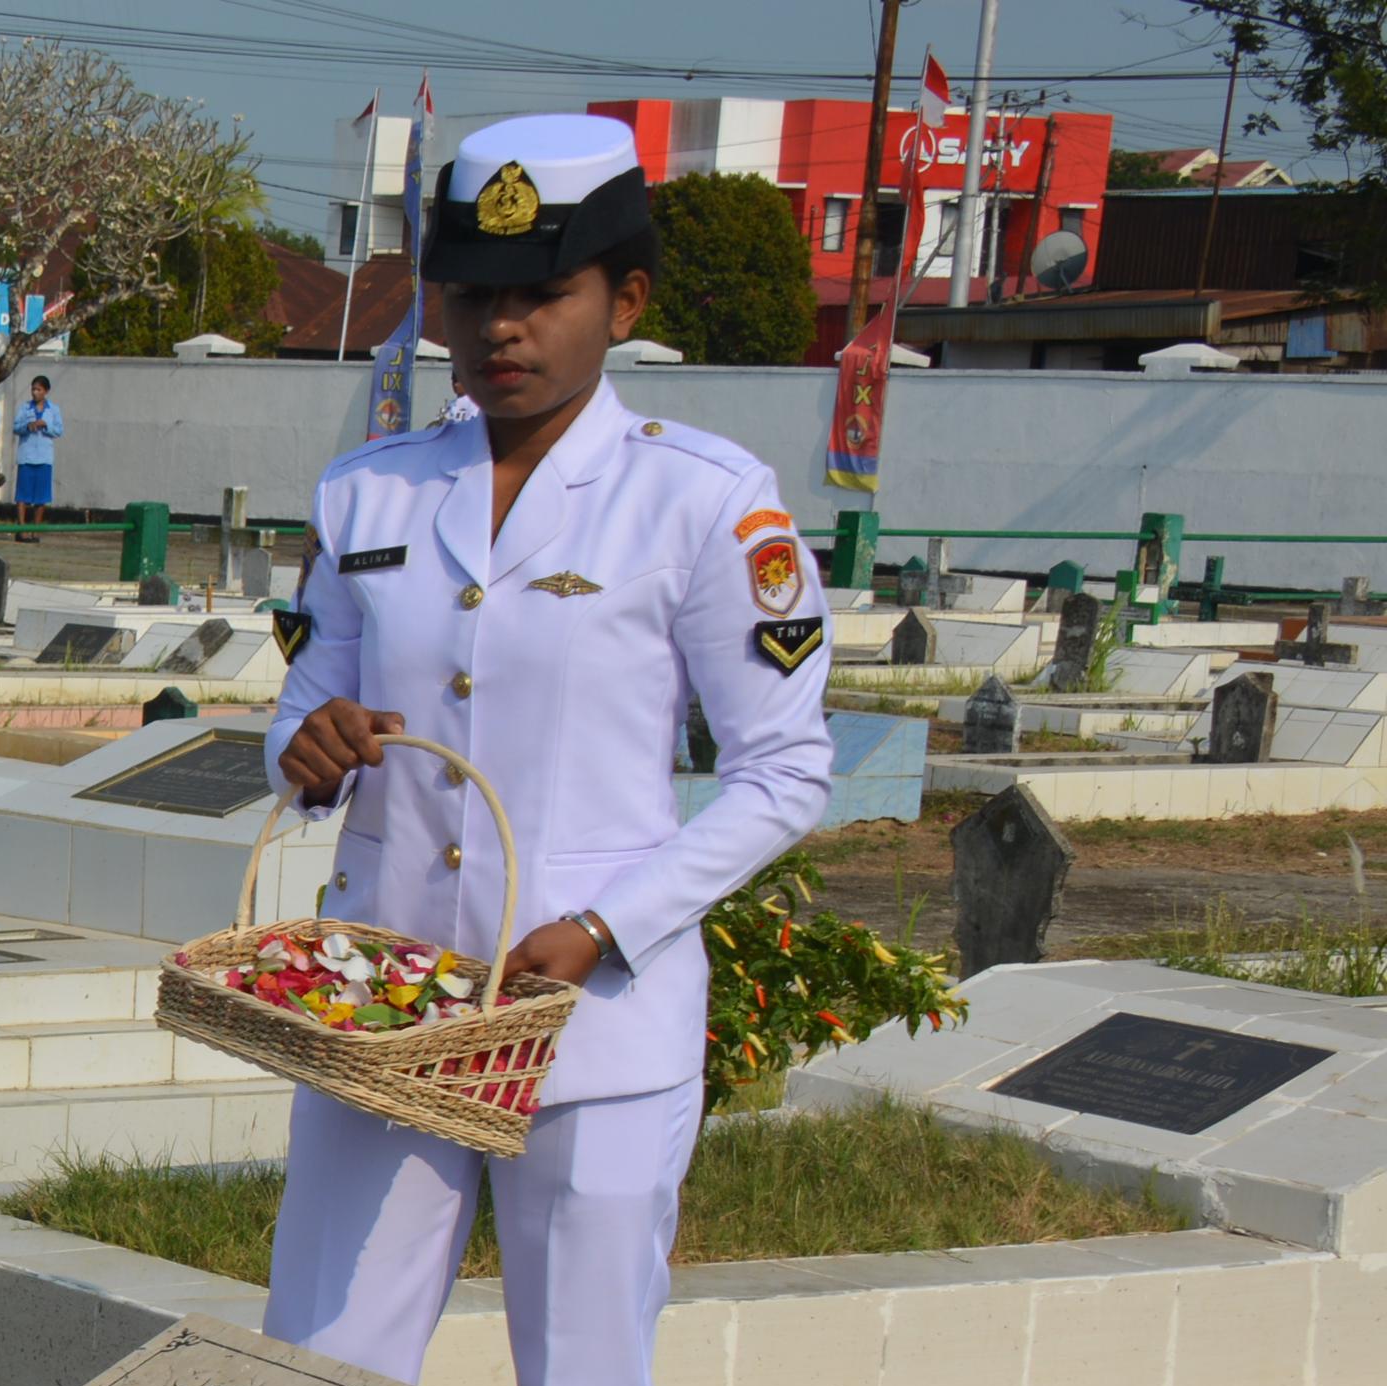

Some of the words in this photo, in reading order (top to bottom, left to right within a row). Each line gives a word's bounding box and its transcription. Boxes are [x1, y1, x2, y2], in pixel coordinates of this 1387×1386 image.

[937, 138, 1030, 167] SNY
[353, 553, 391, 567] ALINA
[776, 625, 806, 638] TNI
